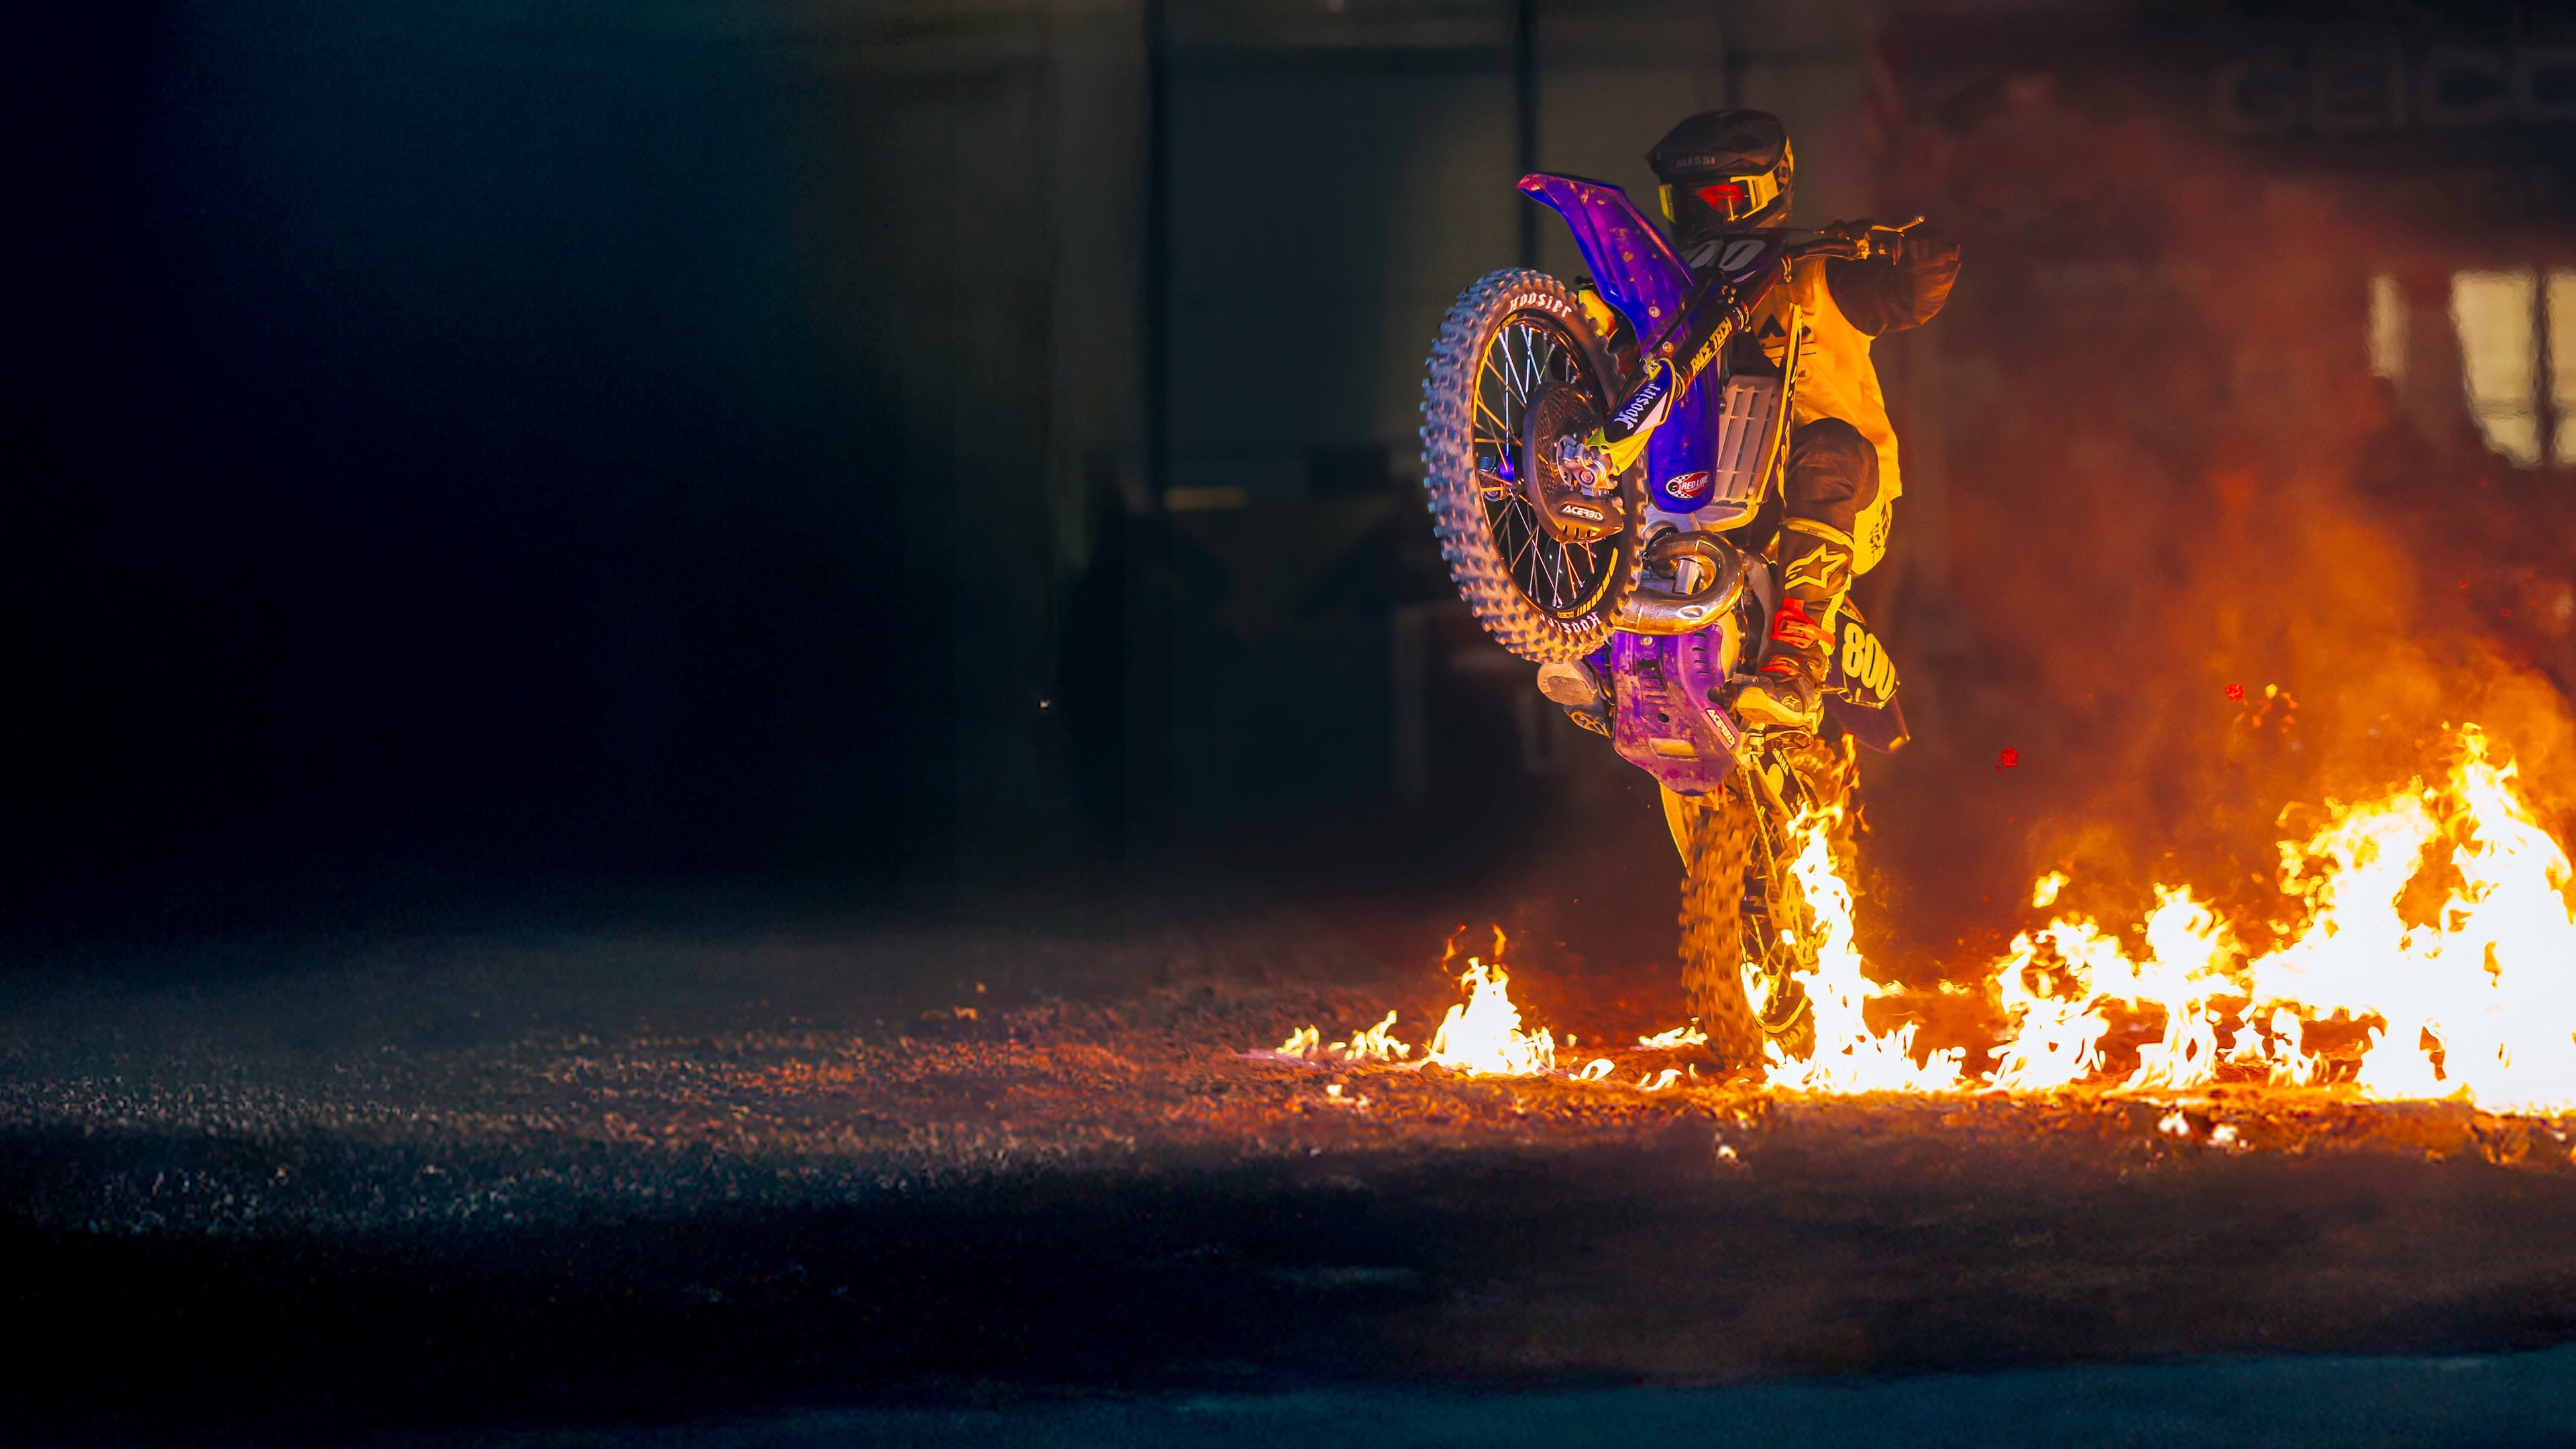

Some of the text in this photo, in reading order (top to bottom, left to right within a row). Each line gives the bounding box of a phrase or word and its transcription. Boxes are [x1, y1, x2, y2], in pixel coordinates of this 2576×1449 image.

[1690, 316, 1733, 376] RACE TECH
[1681, 480, 1697, 490] RED
[1696, 474, 1709, 487] LINE
[1561, 504, 1604, 521] ACERBIS
[1841, 622, 1896, 700] 800
[1706, 709, 1735, 745] ACERBIS
